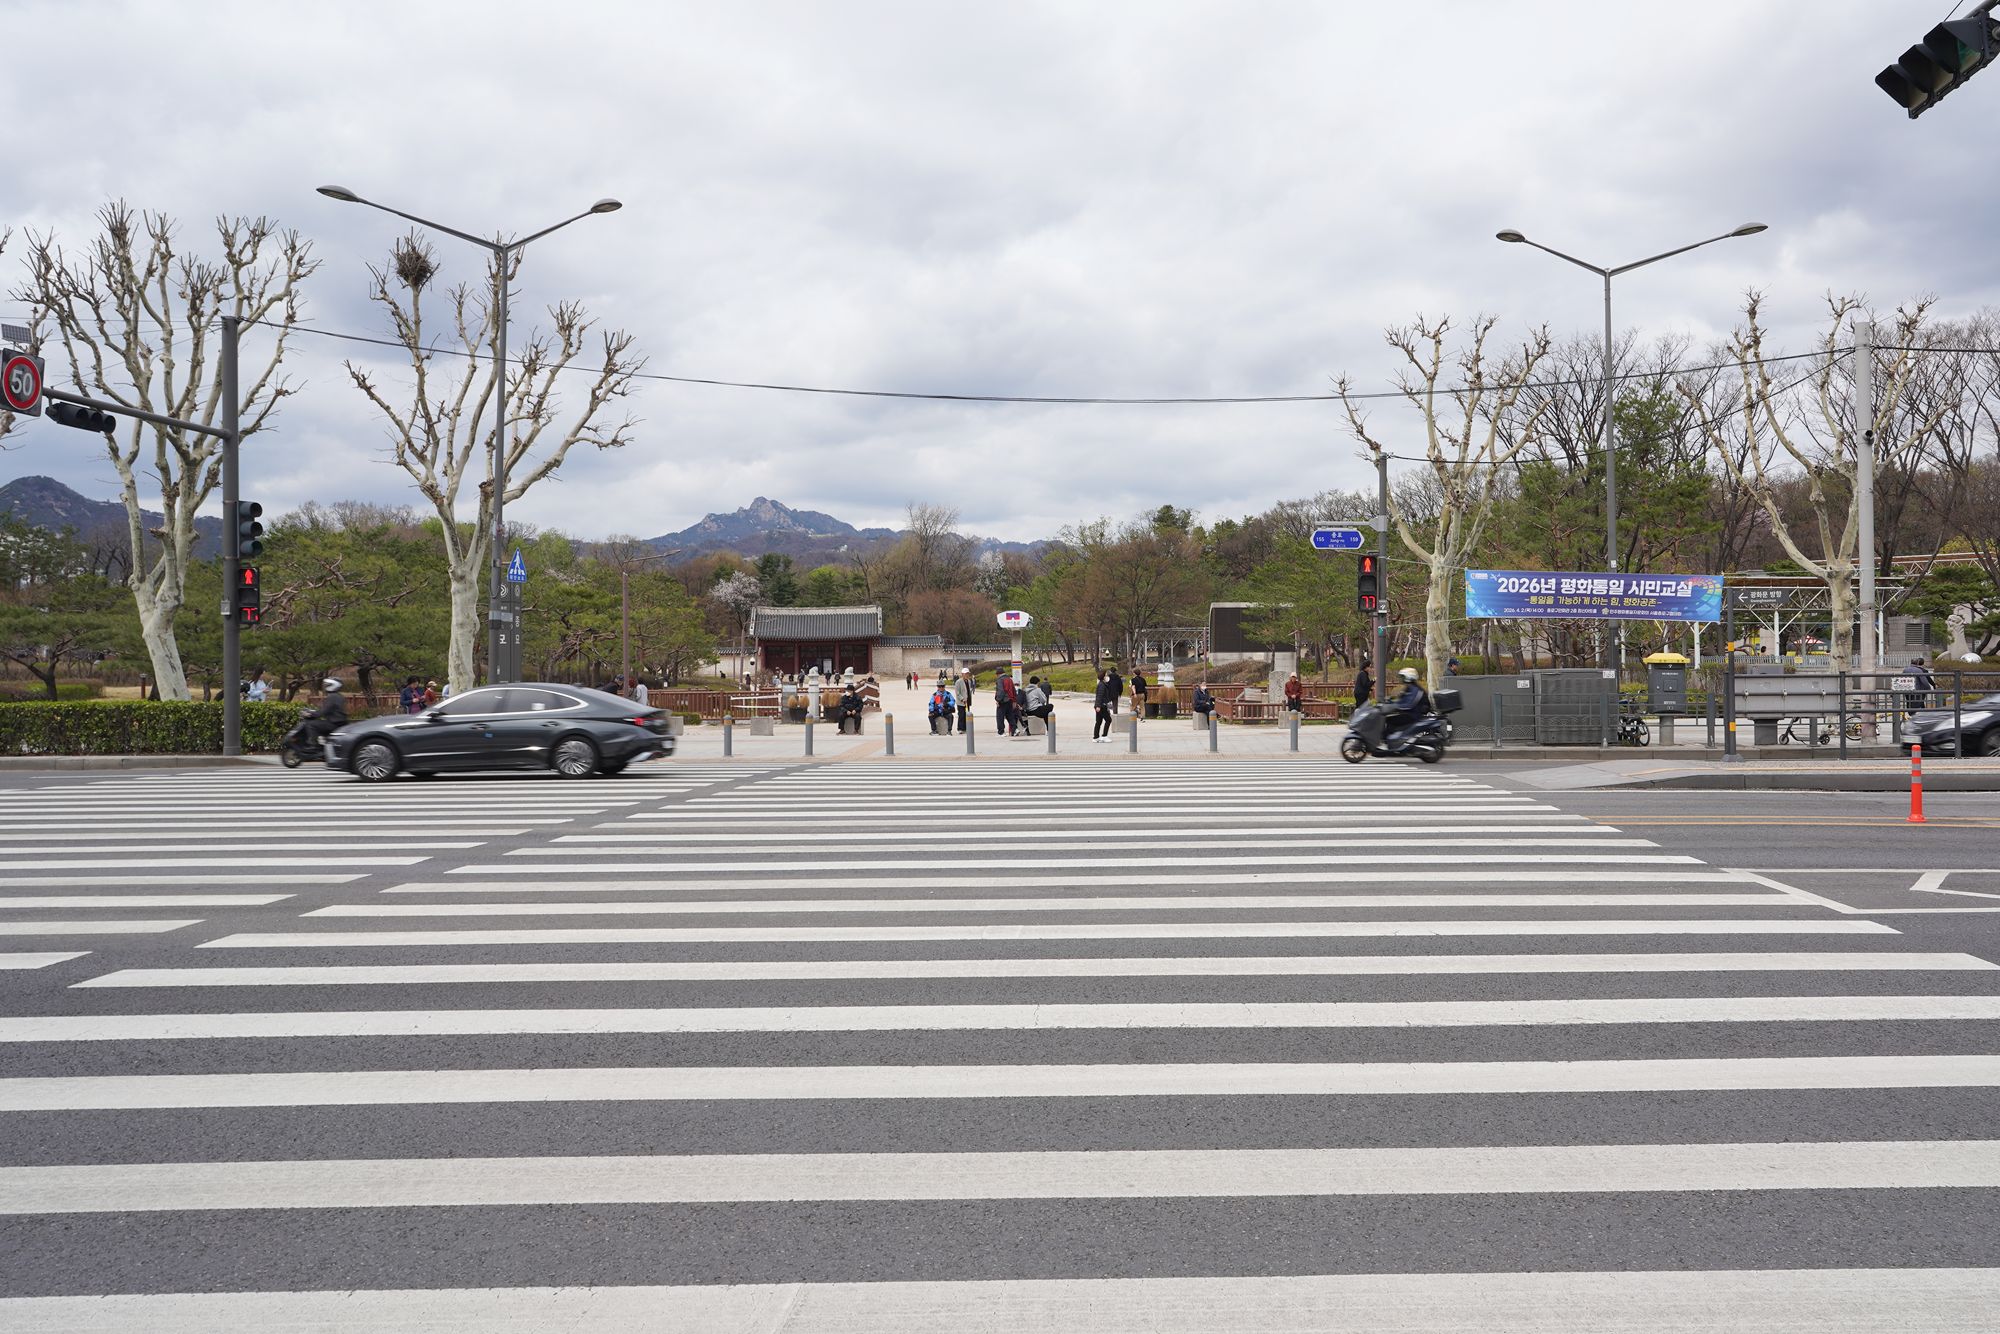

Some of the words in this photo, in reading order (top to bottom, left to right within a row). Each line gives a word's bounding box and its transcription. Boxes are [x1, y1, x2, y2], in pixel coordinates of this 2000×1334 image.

[11, 369, 33, 396] 50
[1497, 577, 1556, 594] 2026년
[1560, 578, 1625, 596] 평화통일
[1627, 580, 1693, 597] 시민교실
[1556, 596, 1591, 605] 가능하게
[1591, 597, 1608, 606] 하는
[1610, 597, 1621, 607] 힘,
[1750, 591, 1768, 599] 광화문
[1769, 590, 1782, 598] 방향
[1361, 595, 1376, 609] 77
